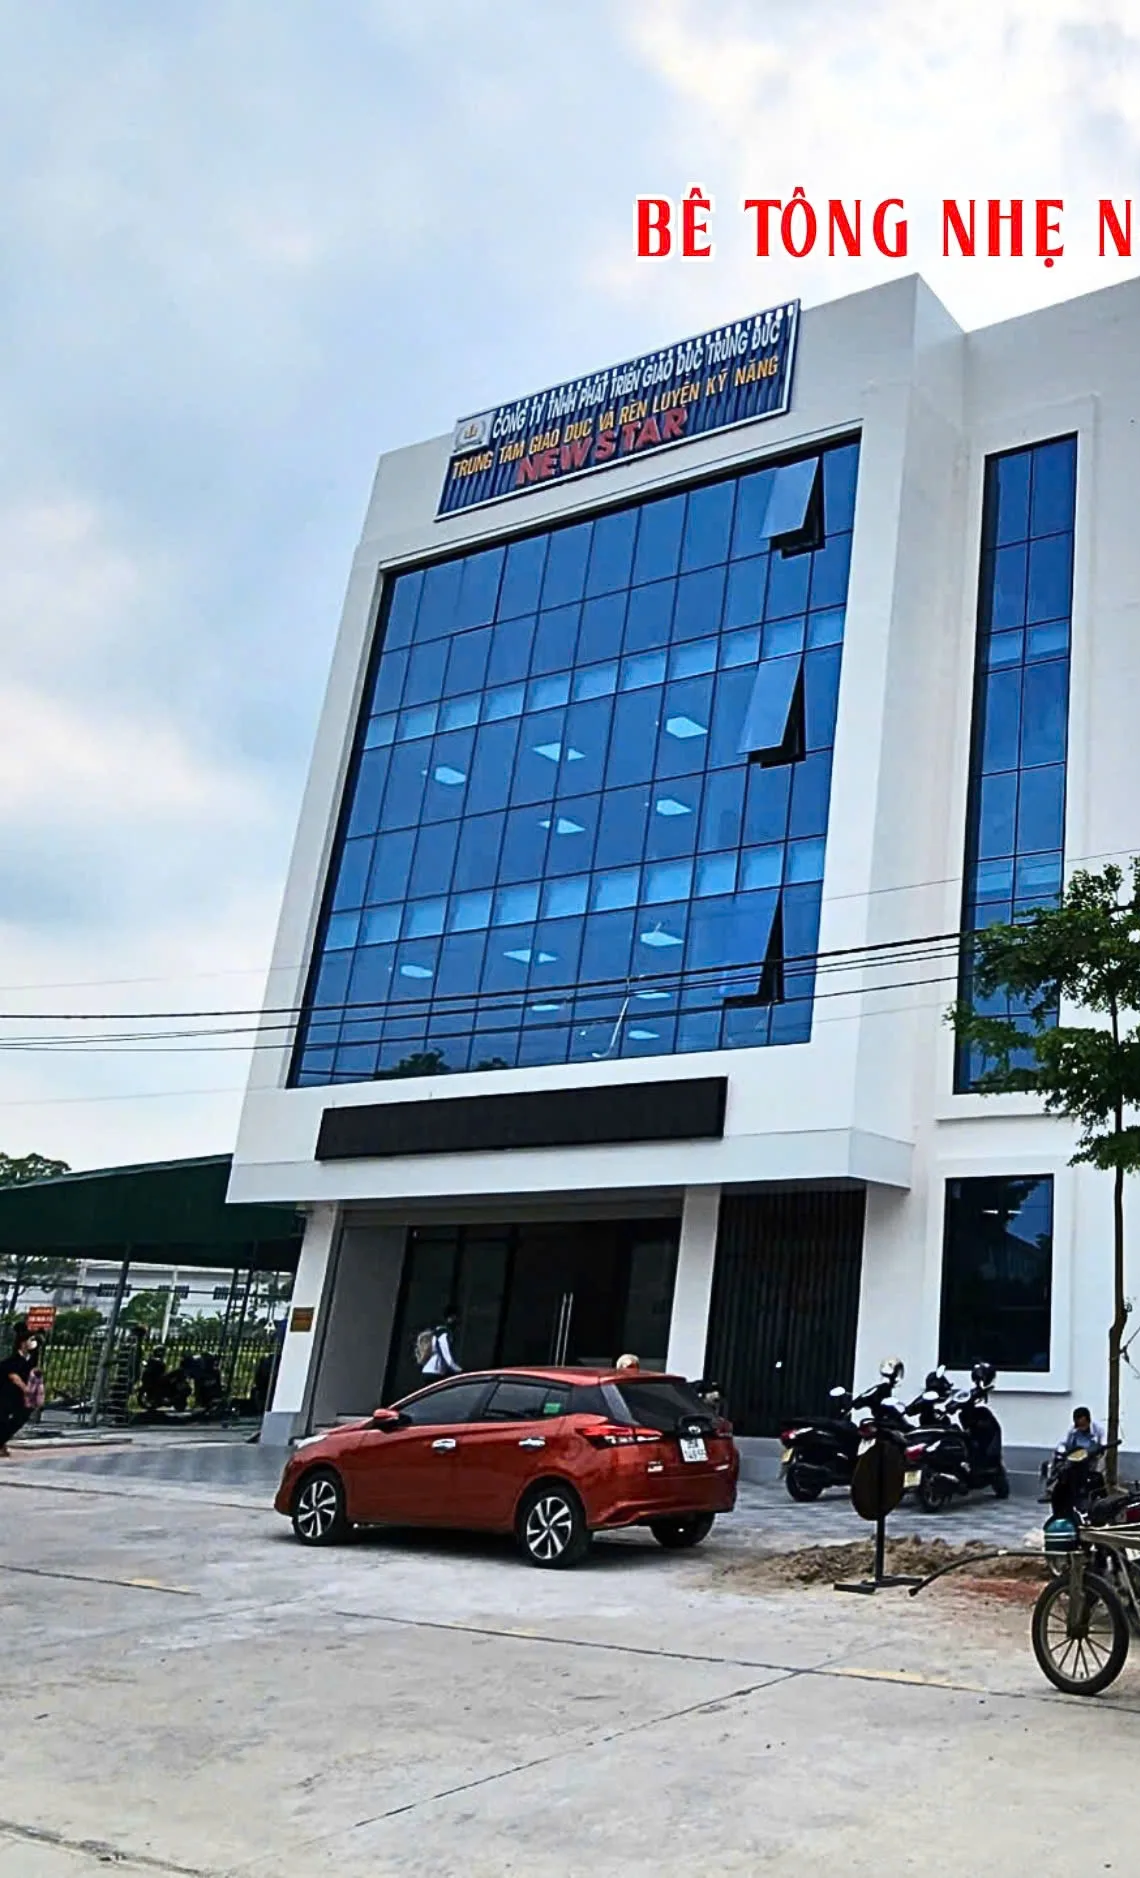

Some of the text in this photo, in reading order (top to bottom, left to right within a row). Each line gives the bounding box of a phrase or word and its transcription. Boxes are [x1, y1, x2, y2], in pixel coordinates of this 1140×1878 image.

[707, 331, 749, 365] TRUNG
[452, 451, 494, 480] TRUNG
[499, 439, 525, 464] TÂM
[515, 408, 688, 484] NEW STAR
